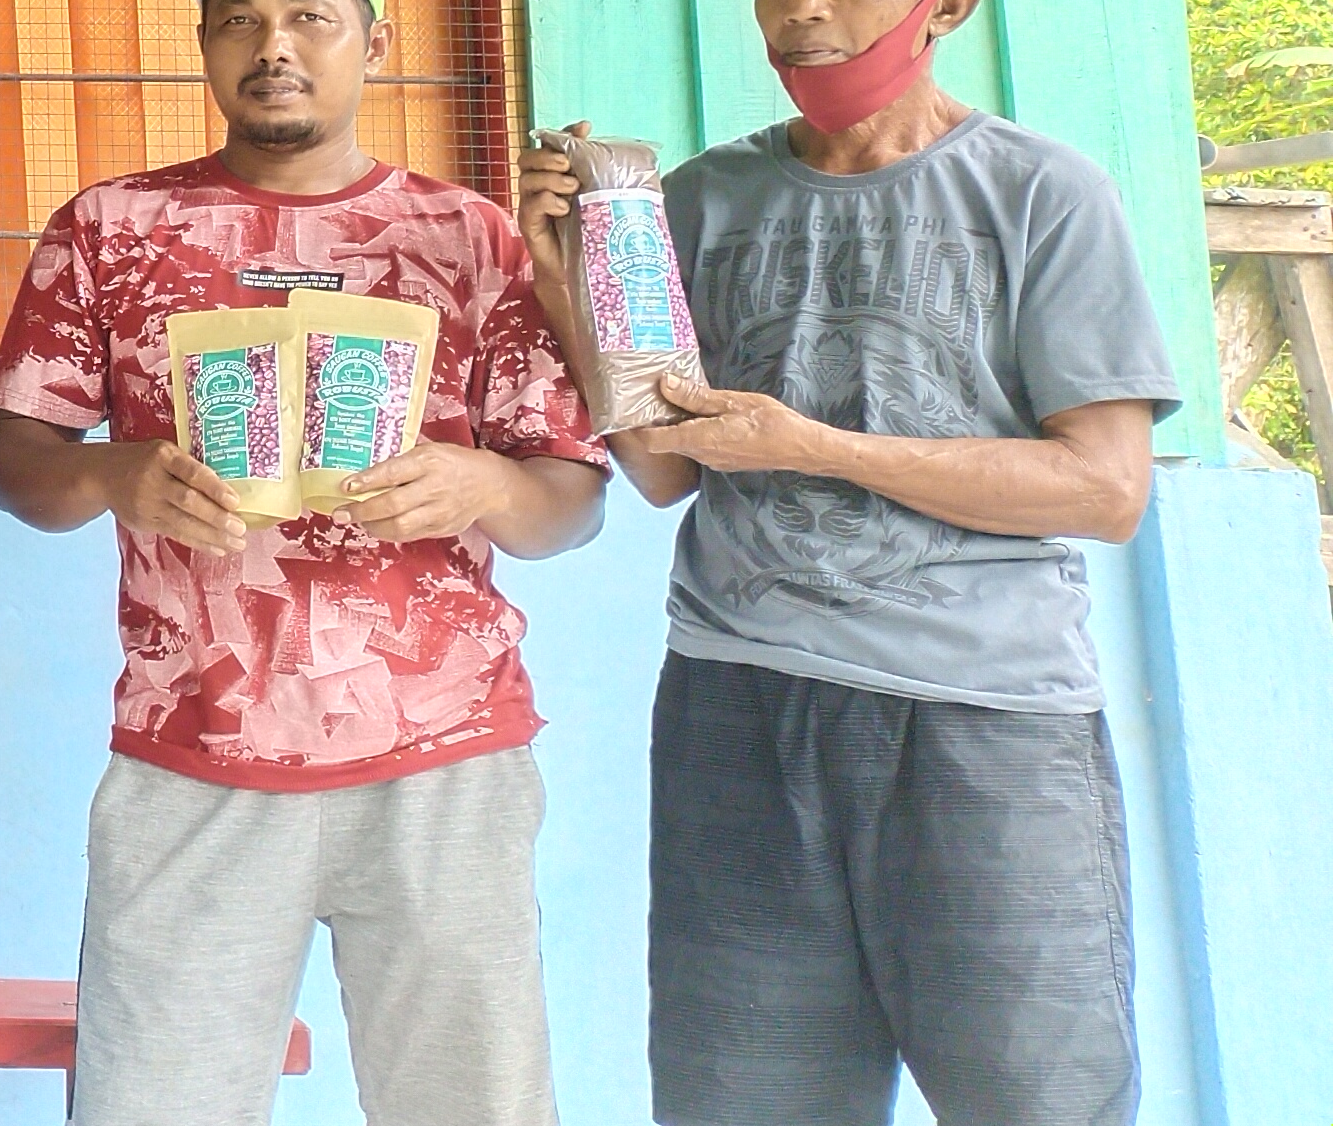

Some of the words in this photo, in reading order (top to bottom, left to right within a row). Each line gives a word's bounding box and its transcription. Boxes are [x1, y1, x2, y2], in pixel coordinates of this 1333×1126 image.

[761, 216, 801, 235] TAU
[812, 214, 892, 235] GAMMA
[904, 215, 946, 235] PHI
[326, 350, 359, 373] SAUGAN
[361, 351, 387, 382] COFFEE
[322, 386, 387, 404] ROBUSTA
[199, 396, 254, 416] ROBUSTA
